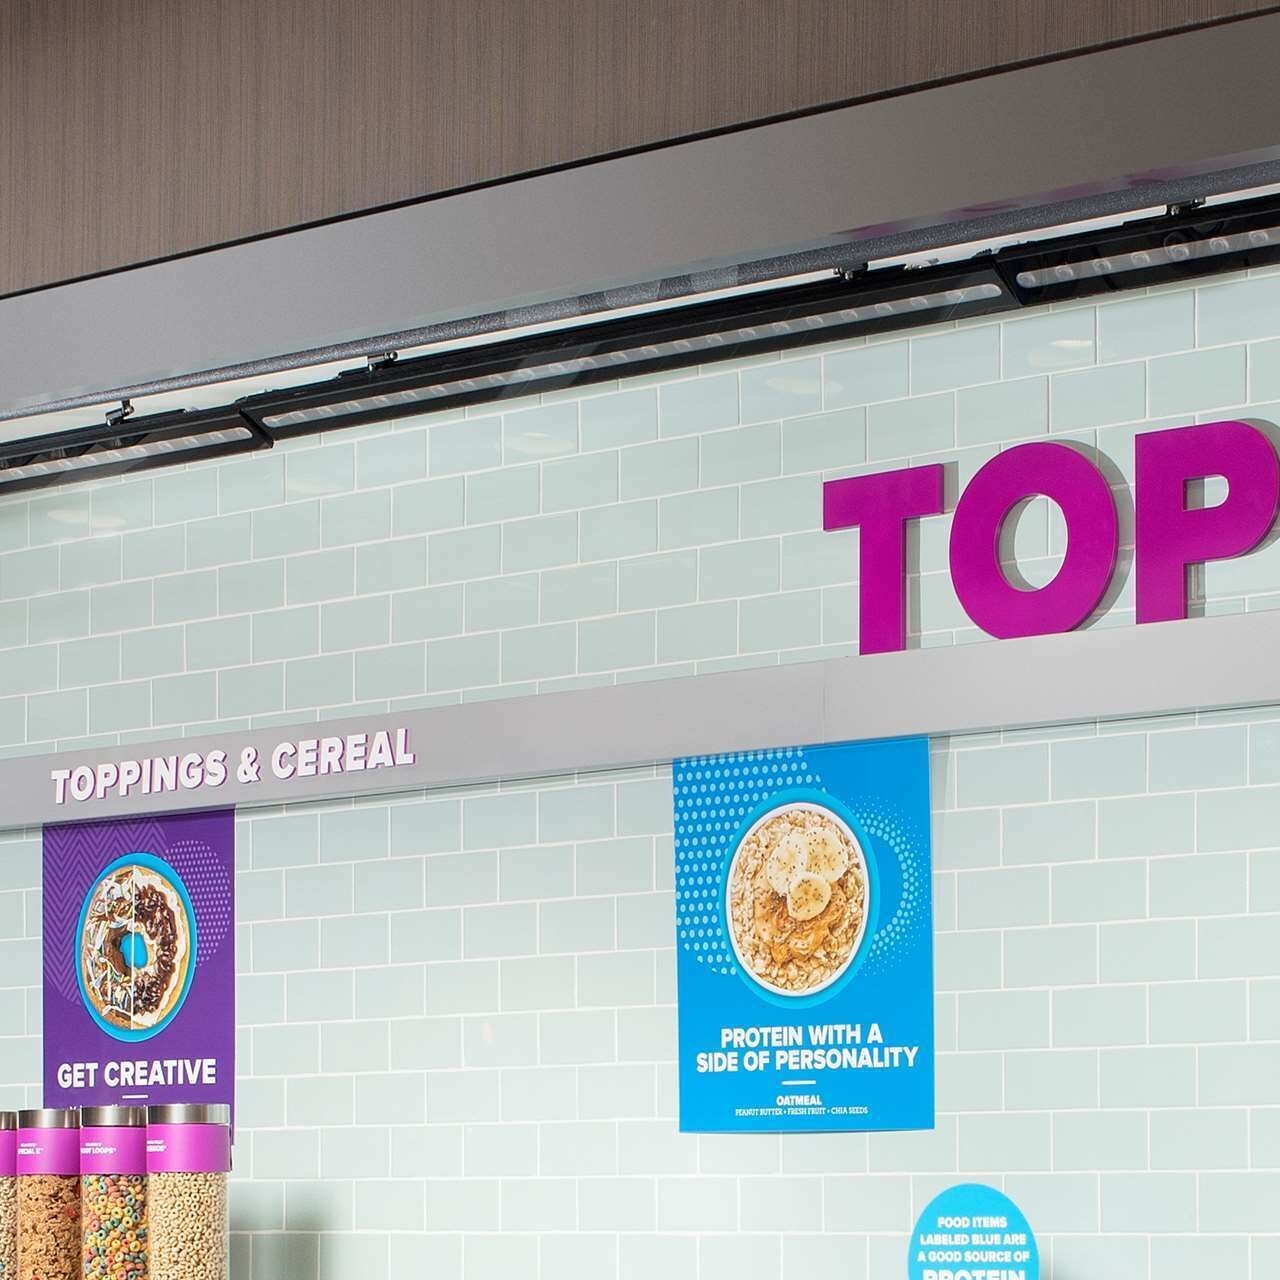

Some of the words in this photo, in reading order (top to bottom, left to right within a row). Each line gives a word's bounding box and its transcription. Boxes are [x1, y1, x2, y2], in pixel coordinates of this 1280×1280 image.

[51, 749, 227, 804] TOPPINGS
[236, 746, 261, 784] &
[270, 728, 416, 779] CEREAL
[721, 1026, 803, 1048] PROTEIN
[808, 1024, 861, 1046] WITH
[867, 1023, 883, 1044] A
[696, 1051, 739, 1073] SIDE
[743, 1050, 770, 1072] OF
[775, 1046, 919, 1070] PERSONALITY
[57, 1062, 98, 1088] GET
[104, 1058, 217, 1087] CREATIVE
[776, 1095, 823, 1106] OATMEAL
[831, 1106, 848, 1115] CHIA
[937, 1216, 970, 1228] FOOD
[973, 1216, 1007, 1228] ITEMS
[920, 1234, 969, 1245] LABELED
[972, 1234, 1001, 1245] BLUE
[1003, 1233, 1026, 1245] ARE
[917, 1251, 926, 1262] A
[928, 1251, 962, 1262] GOOD
[964, 1251, 1011, 1262] SOURCE
[1013, 1251, 1030, 1262] OF
